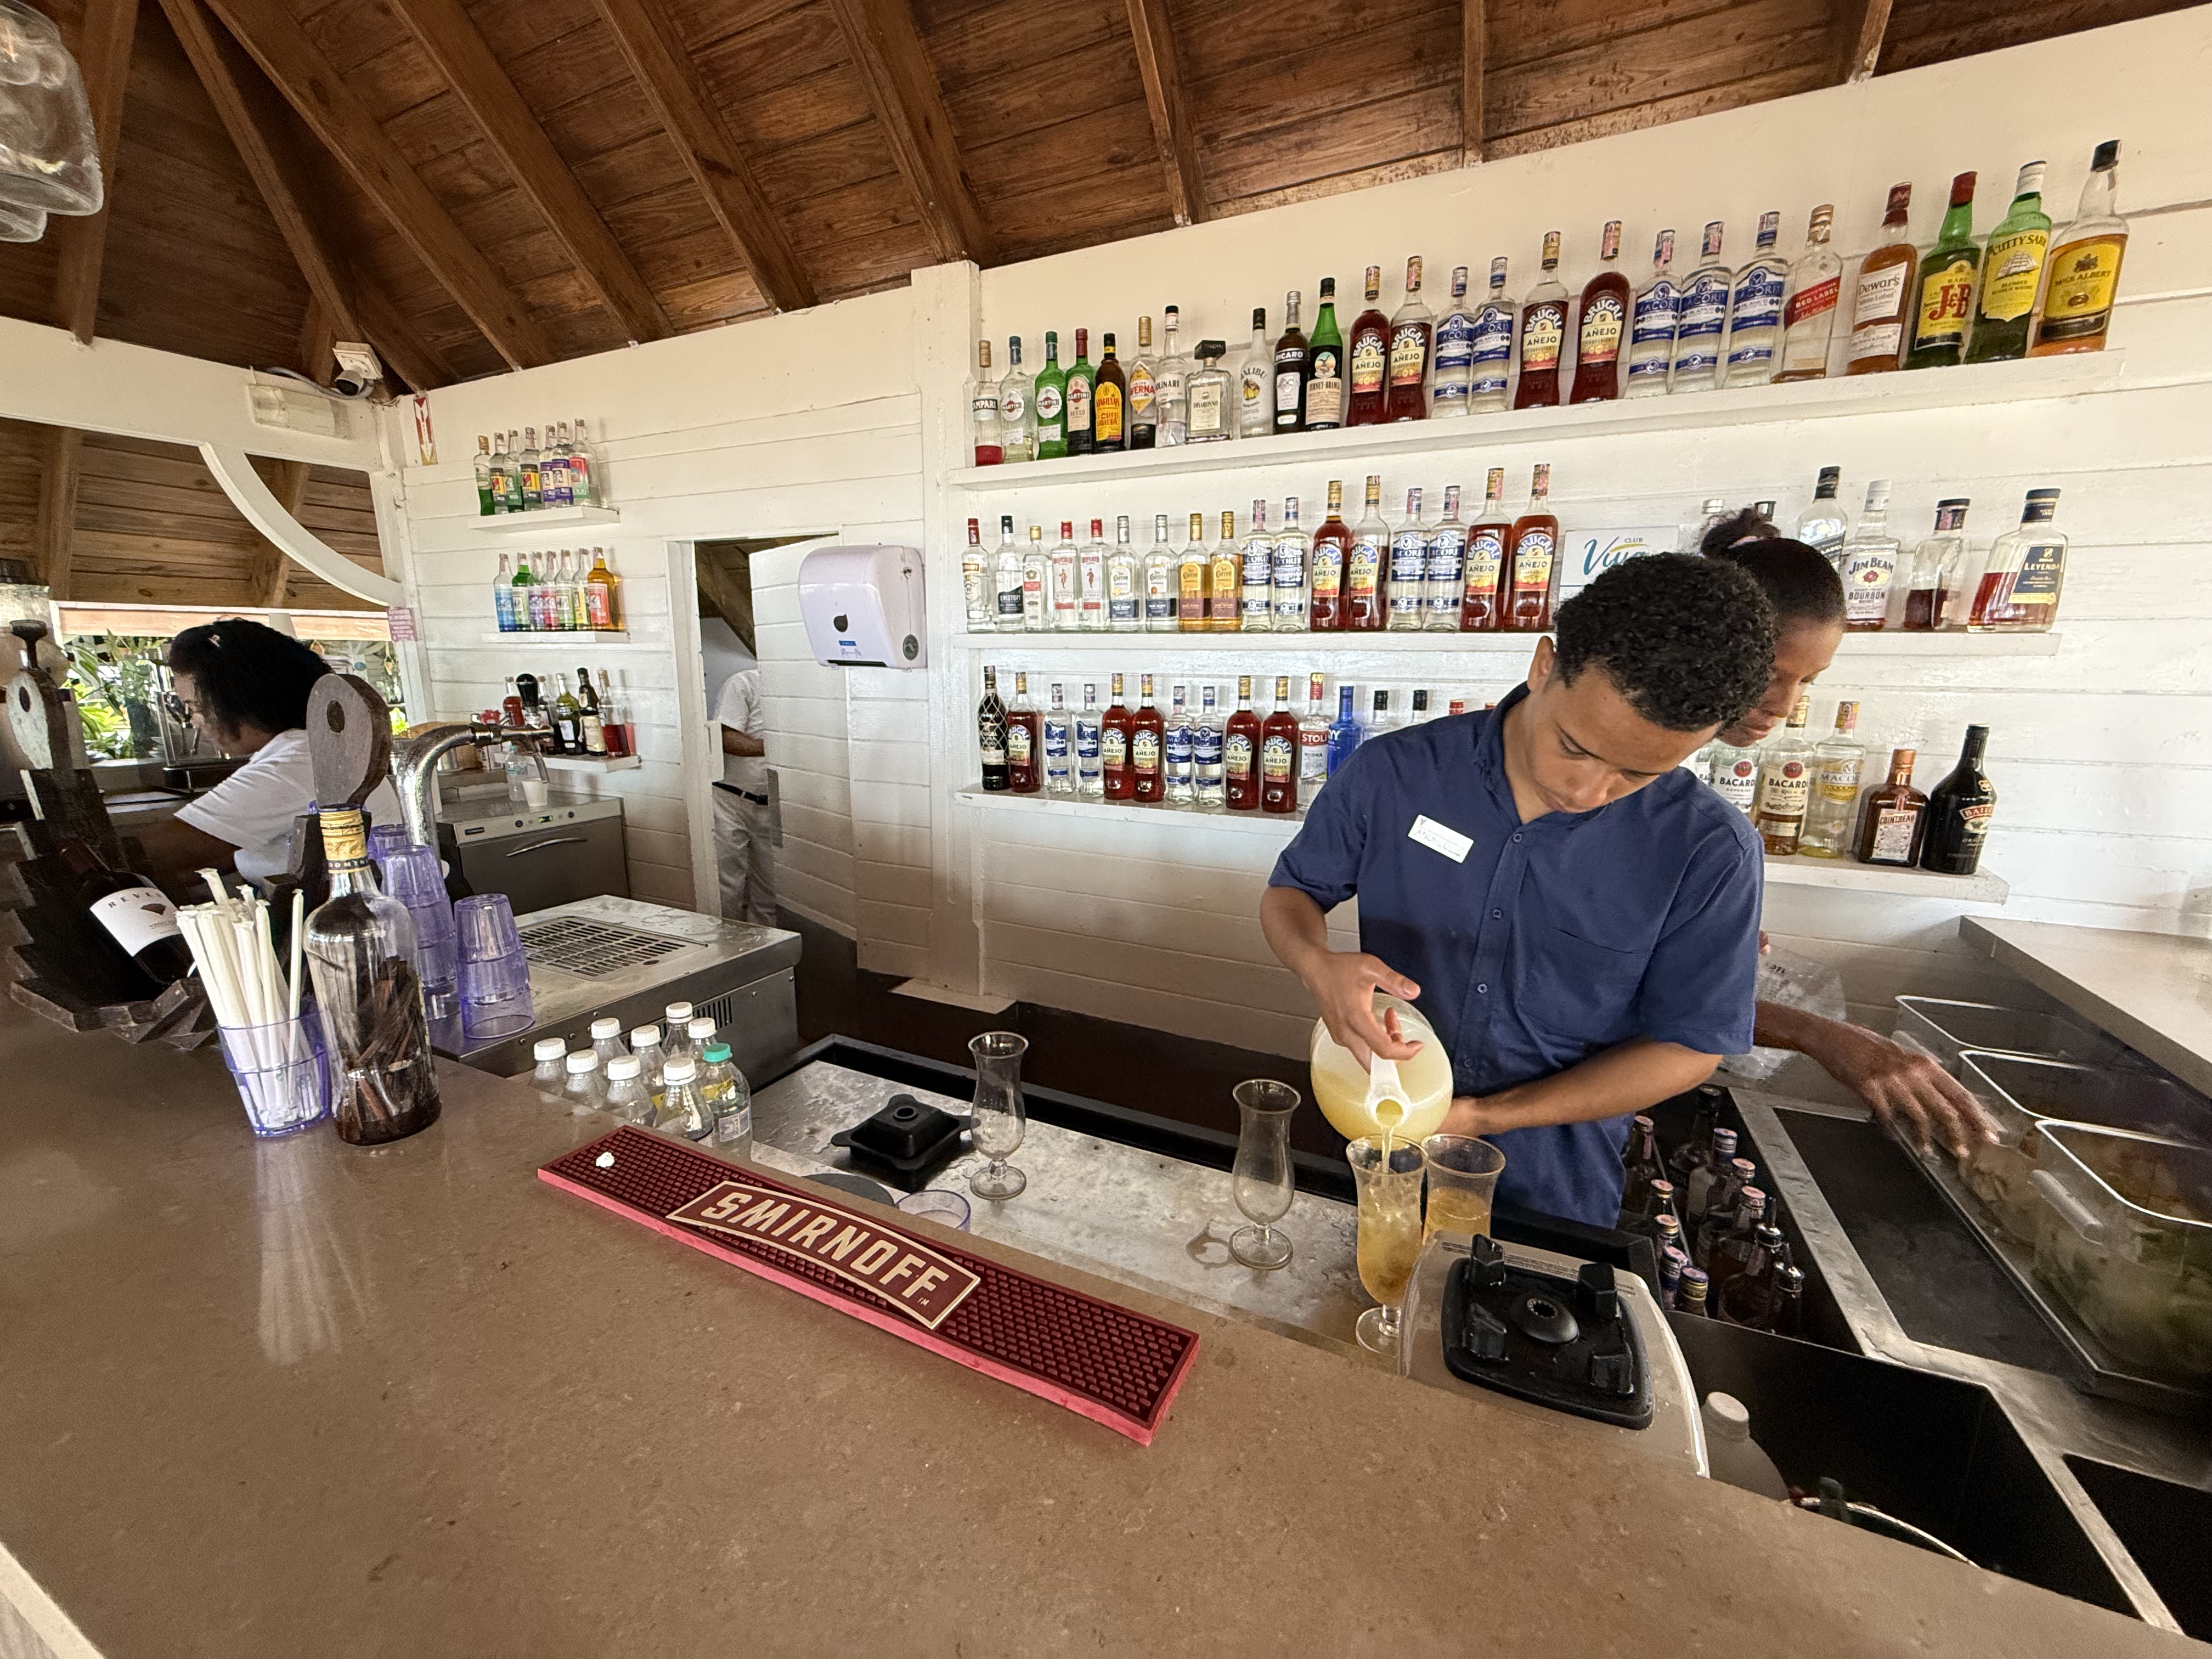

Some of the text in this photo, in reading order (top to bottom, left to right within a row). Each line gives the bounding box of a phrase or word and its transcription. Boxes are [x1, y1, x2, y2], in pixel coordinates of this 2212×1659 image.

[1988, 235, 2046, 255] CUTTY SARK
[2077, 270, 2112, 280] ALBERT
[1859, 276, 1900, 296] Dewar's
[1796, 297, 1812, 308] RED
[1814, 287, 1838, 301] LABEL
[1928, 284, 1971, 320] J&B
[1525, 308, 1562, 331] BRUGAL
[1583, 300, 1622, 323] BRUGAL
[1391, 328, 1425, 349] BRUGAL
[1527, 336, 1556, 346] AÑEJO
[1585, 328, 1616, 338] AÑEJO
[1353, 336, 1385, 357] BRUGAL
[1276, 351, 1304, 362] RICARD
[1393, 353, 1420, 363] AÑEJO
[1240, 367, 1267, 380] MALIBU
[1355, 361, 1381, 370] AÑEJO
[1068, 392, 1090, 401] MARTINI
[1468, 539, 1500, 559] BRUGAL
[1517, 535, 1552, 555] BRUGAL
[1313, 548, 1341, 564] BRUGAL
[1350, 546, 1375, 562] BRUGAL
[1849, 557, 1894, 575] JIM BEAM
[1849, 591, 1884, 600] BOURBON
[1103, 729, 1125, 743] BRUGAL
[1133, 731, 1159, 746] BRUGAL
[1226, 735, 1251, 751] BRUGAL
[1302, 733, 1327, 742] STOLI
[1264, 737, 1290, 754] BRUGAL
[1720, 777, 1754, 786] BACARD
[1769, 778, 1808, 788] BACARDI
[1880, 814, 1915, 825] COINTREAU
[701, 1192, 950, 1299] SMIRNOFF
